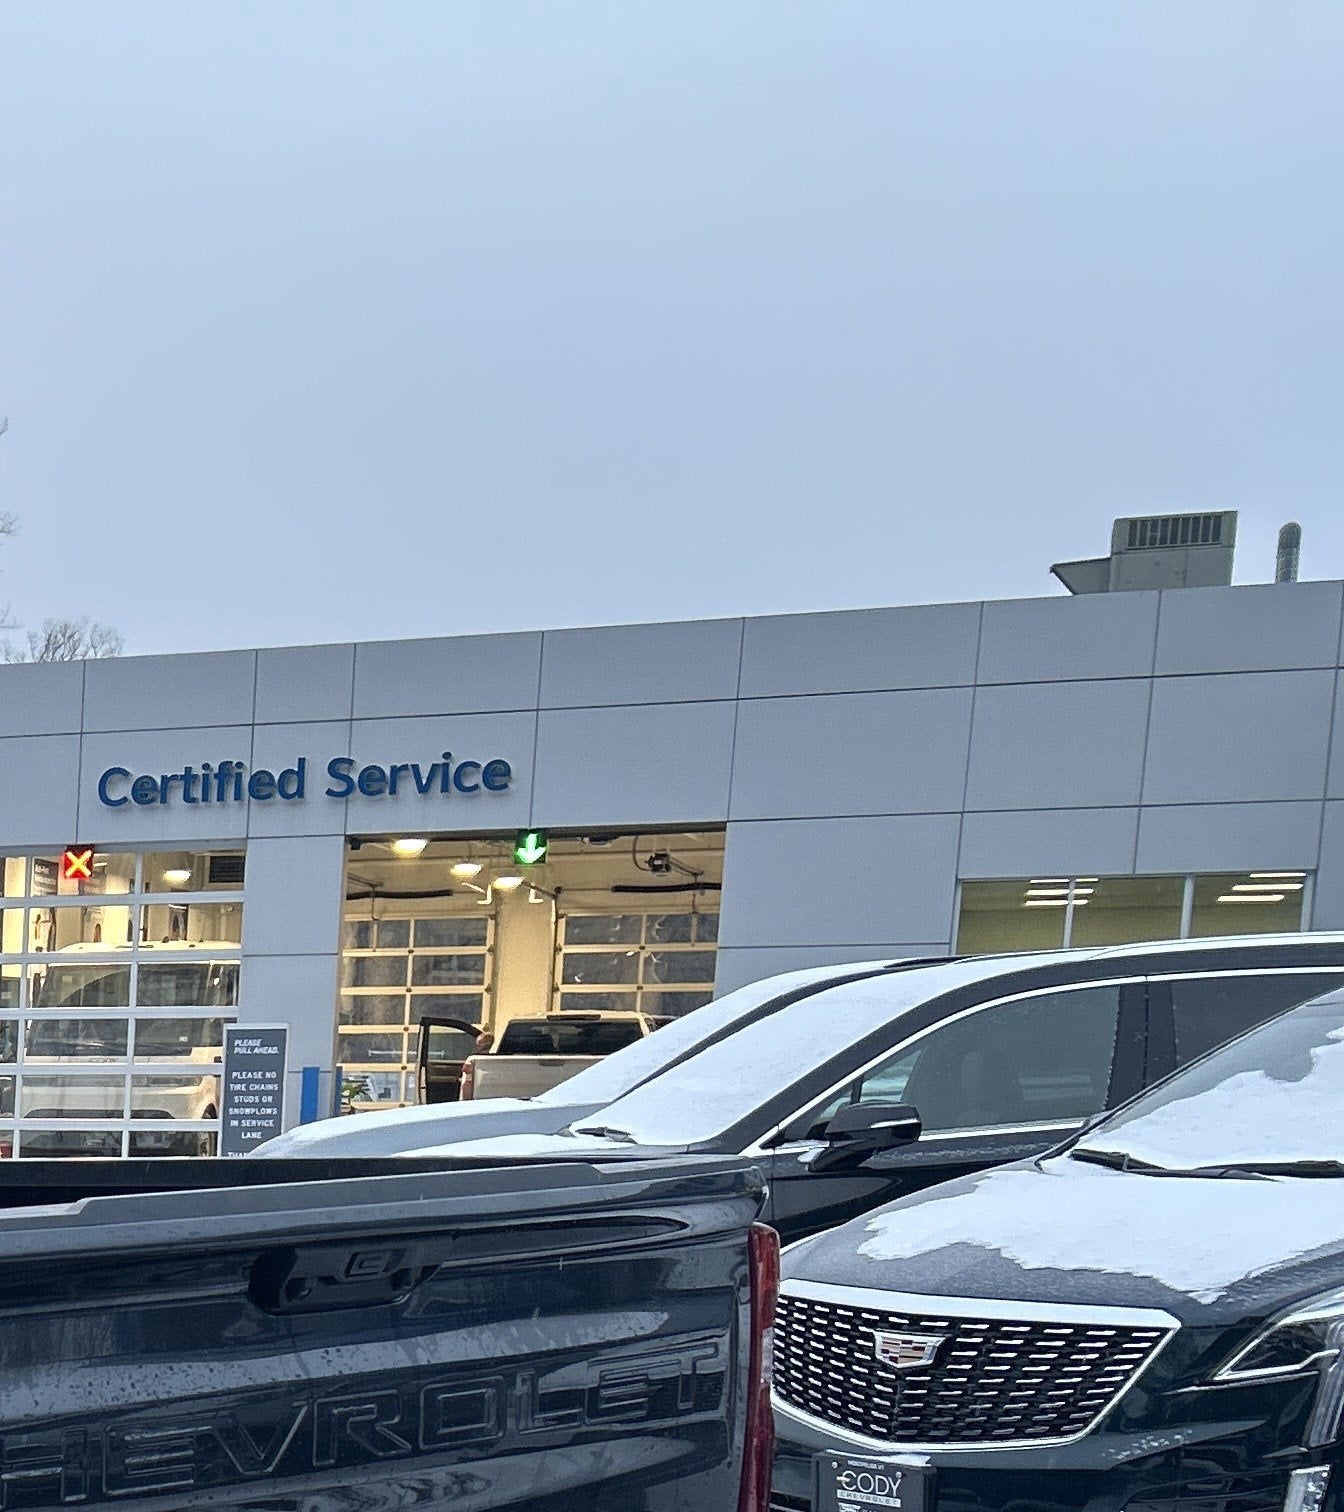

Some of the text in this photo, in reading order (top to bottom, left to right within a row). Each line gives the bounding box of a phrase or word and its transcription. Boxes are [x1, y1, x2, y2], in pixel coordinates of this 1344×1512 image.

[98, 752, 513, 808] Certified Service
[234, 1039, 262, 1047] PLEASE
[232, 1071, 277, 1079] PLEASE NO
[229, 1083, 279, 1091] TIRE CHAINS
[234, 1095, 273, 1103] STUDS OR
[228, 1107, 278, 1115] SNOWPLOWS
[241, 1119, 274, 1127] SERVICE
[241, 1131, 262, 1139] LANE
[836, 1470, 901, 1497] CODY
[839, 1491, 897, 1506] CHEVROLET
